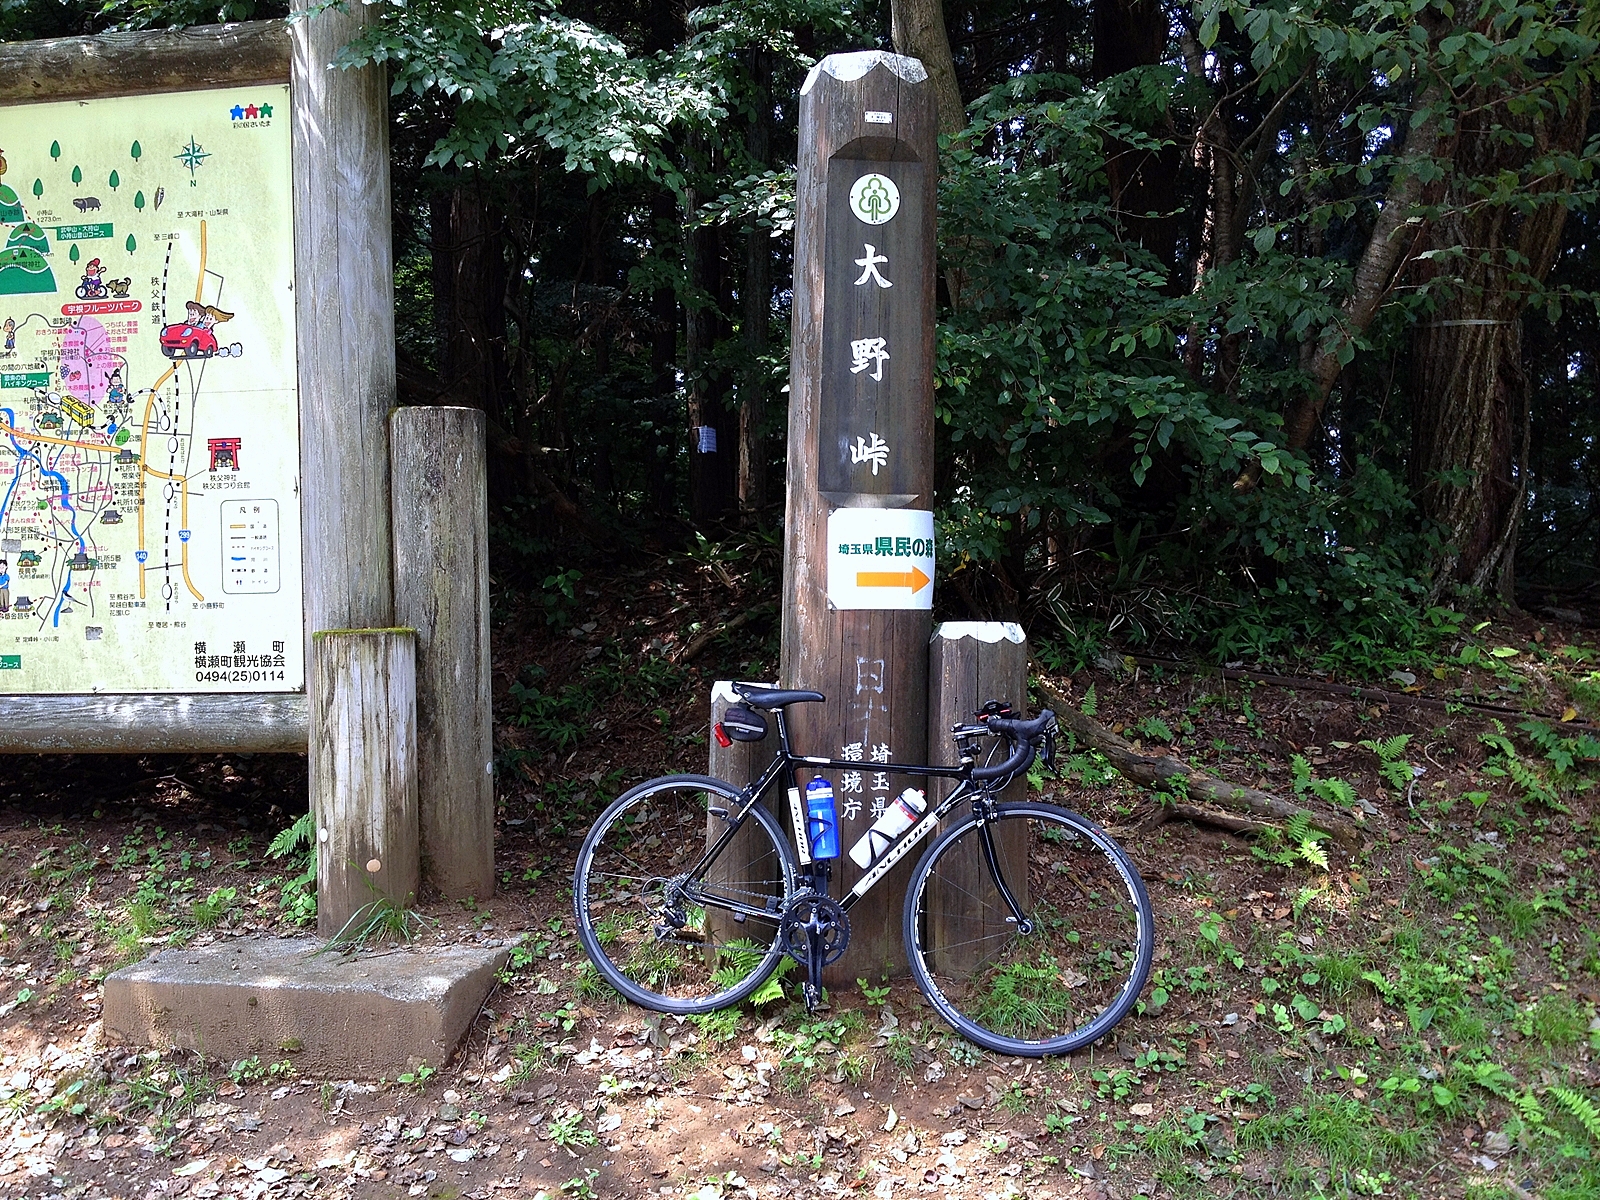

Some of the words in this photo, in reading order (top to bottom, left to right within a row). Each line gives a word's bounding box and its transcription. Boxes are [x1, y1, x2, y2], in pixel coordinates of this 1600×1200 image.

[68, 302, 140, 314] 宇根フルーツパーク
[151, 276, 161, 325] 秩父鉄道
[849, 243, 893, 476] 大野峠
[136, 552, 147, 560] 140
[194, 654, 285, 669] 横瀬町観光協会
[195, 670, 285, 683] 0494(25)0114
[840, 742, 864, 820] 環境庁
